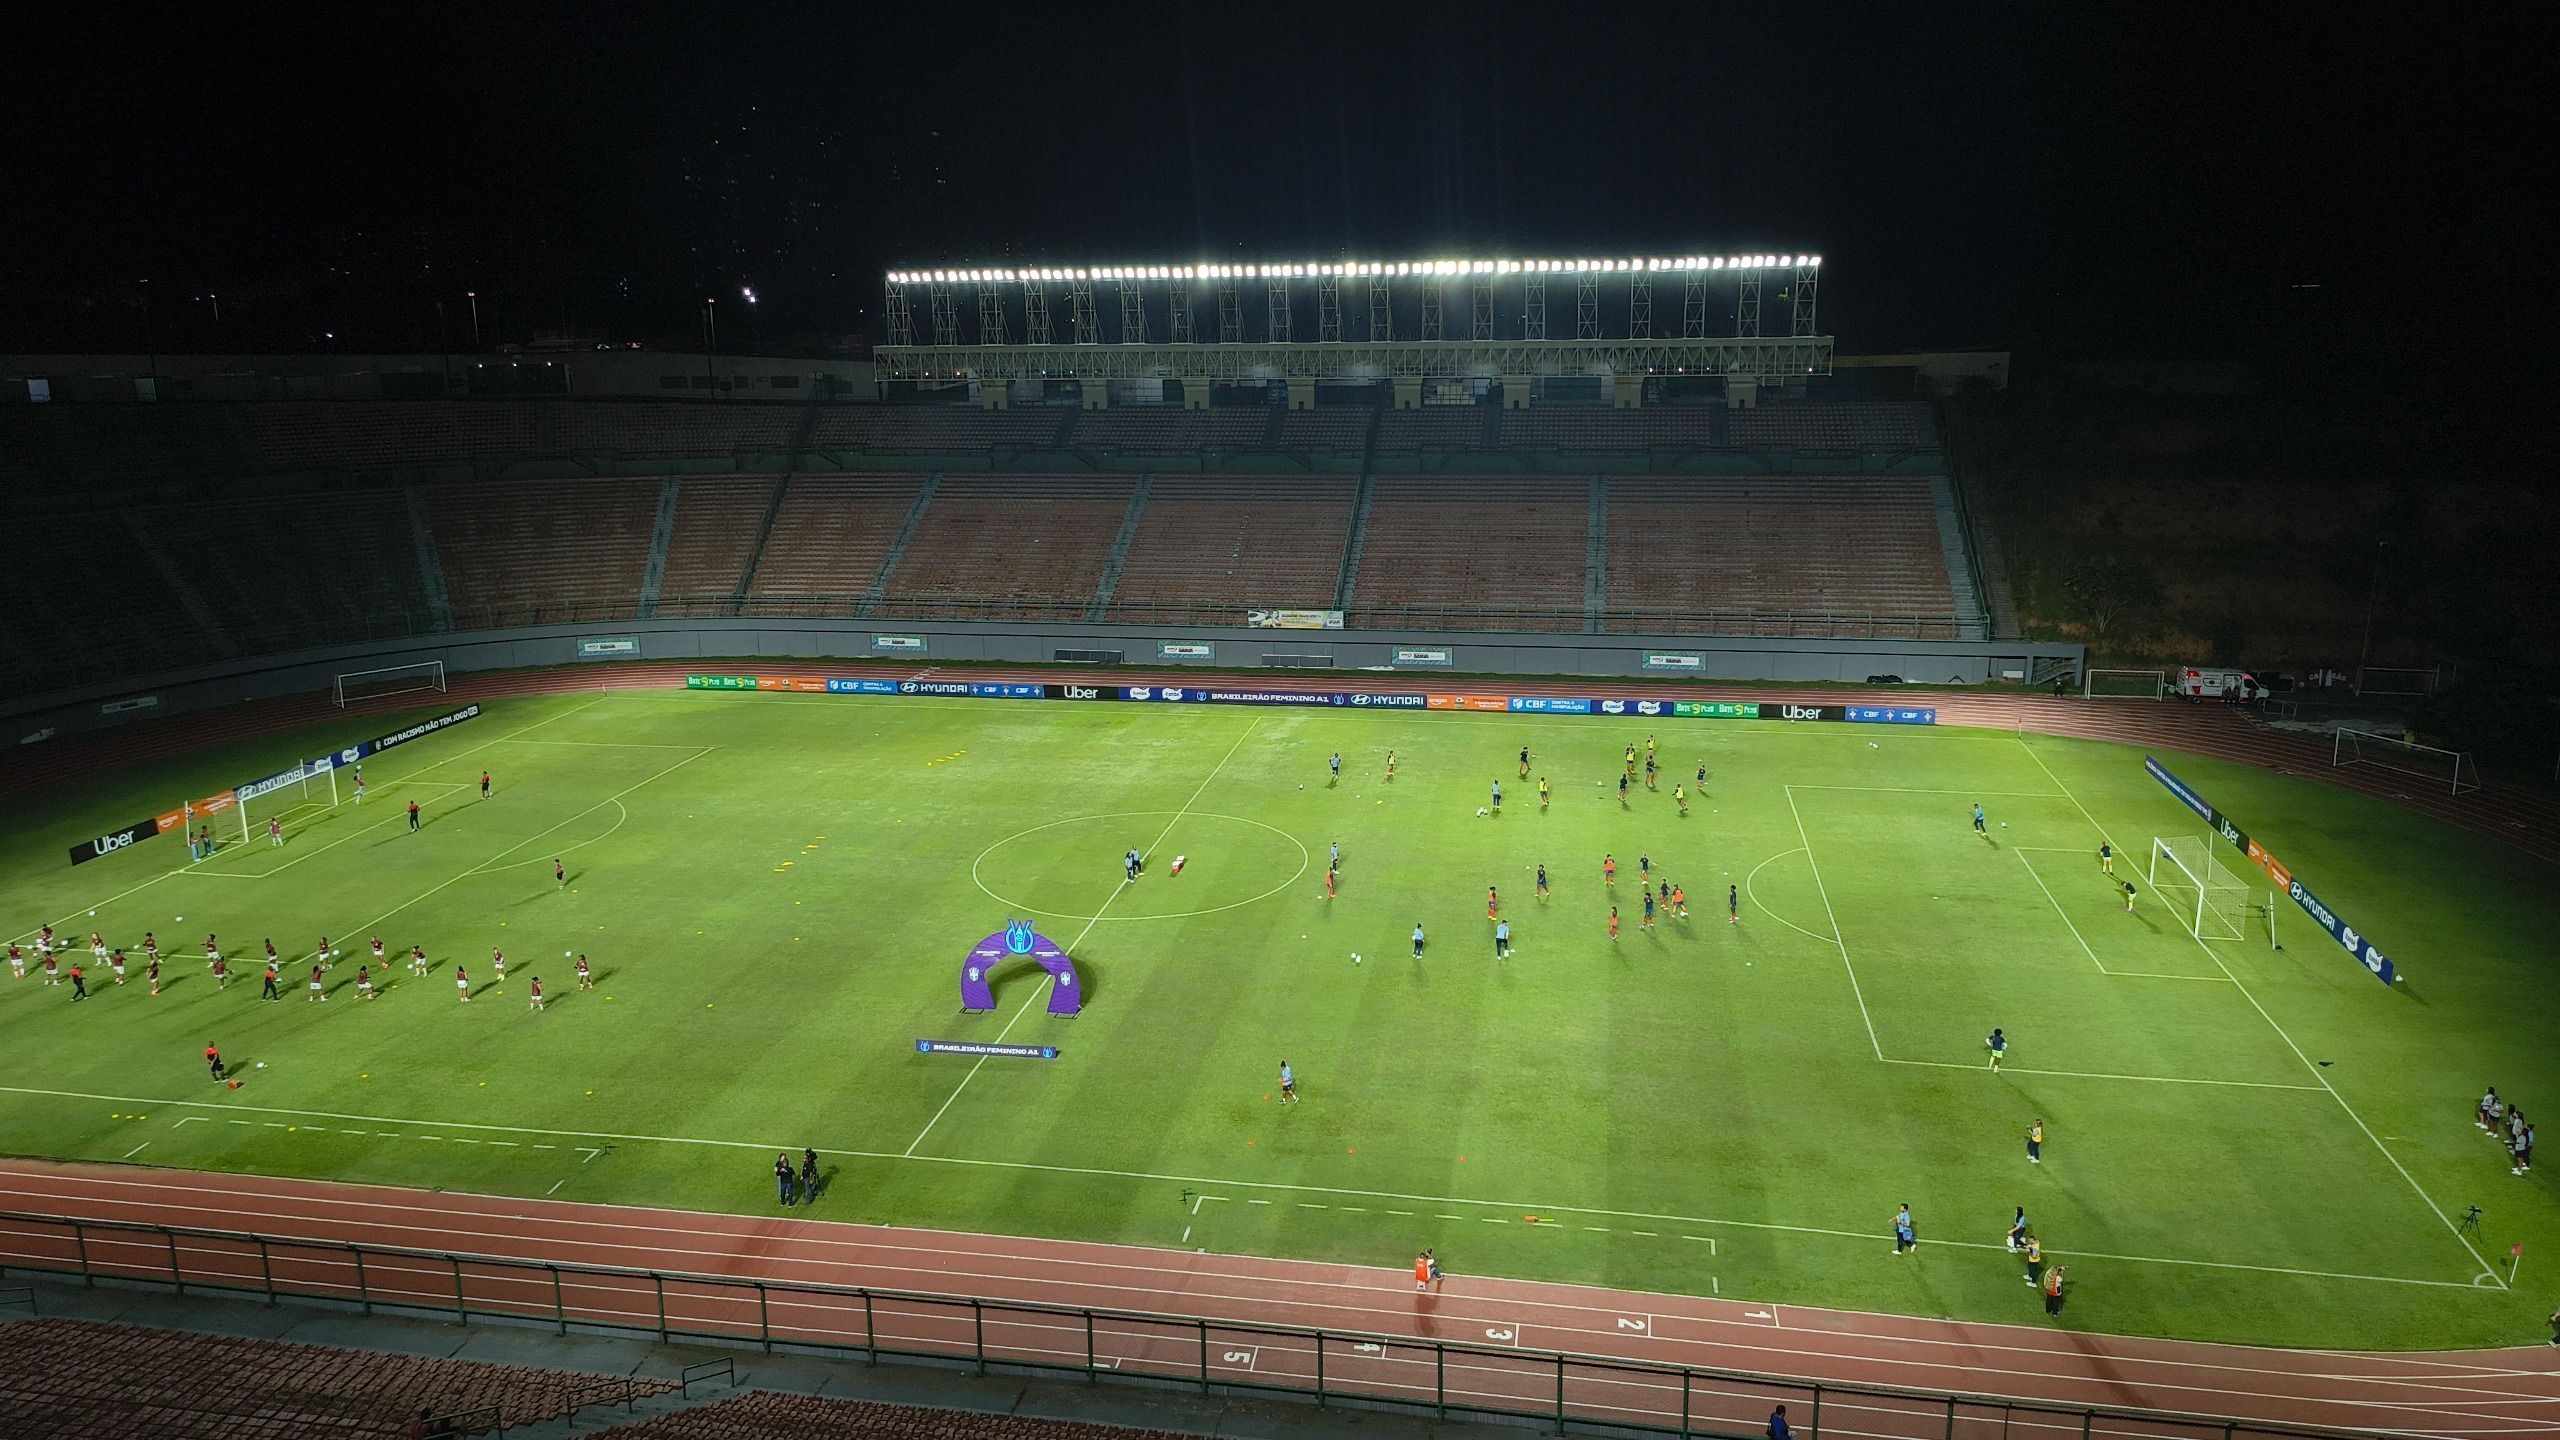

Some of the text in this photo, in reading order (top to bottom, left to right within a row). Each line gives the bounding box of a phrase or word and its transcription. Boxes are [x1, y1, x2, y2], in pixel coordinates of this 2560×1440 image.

[841, 681, 859, 690] CBF
[920, 683, 968, 693] HYUNDAI
[1064, 685, 1098, 699] Uber
[1211, 693, 1329, 703] BRASILEIRÃO FEMININO A1
[1373, 696, 1424, 705] HYUNDAI
[1526, 700, 1546, 709] CBF
[1782, 705, 1821, 720] Uber
[1863, 710, 1879, 718] CBF
[383, 735, 398, 746] COM
[398, 725, 425, 741] RACISMO
[425, 720, 439, 732] NÃO
[439, 715, 452, 727] TEM
[453, 710, 468, 722] JOGO
[257, 768, 304, 792] HYUNDAI
[2220, 817, 2239, 846] Uber
[94, 830, 135, 855] Uber
[2302, 892, 2335, 931] HYUNDAI
[933, 1044, 986, 1053] BRASILEIRÃO
[987, 1048, 1026, 1056] FEMININO
[1618, 1317, 1645, 1330] 2
[1485, 1328, 1513, 1341] 3
[1223, 1351, 1251, 1364] 5
